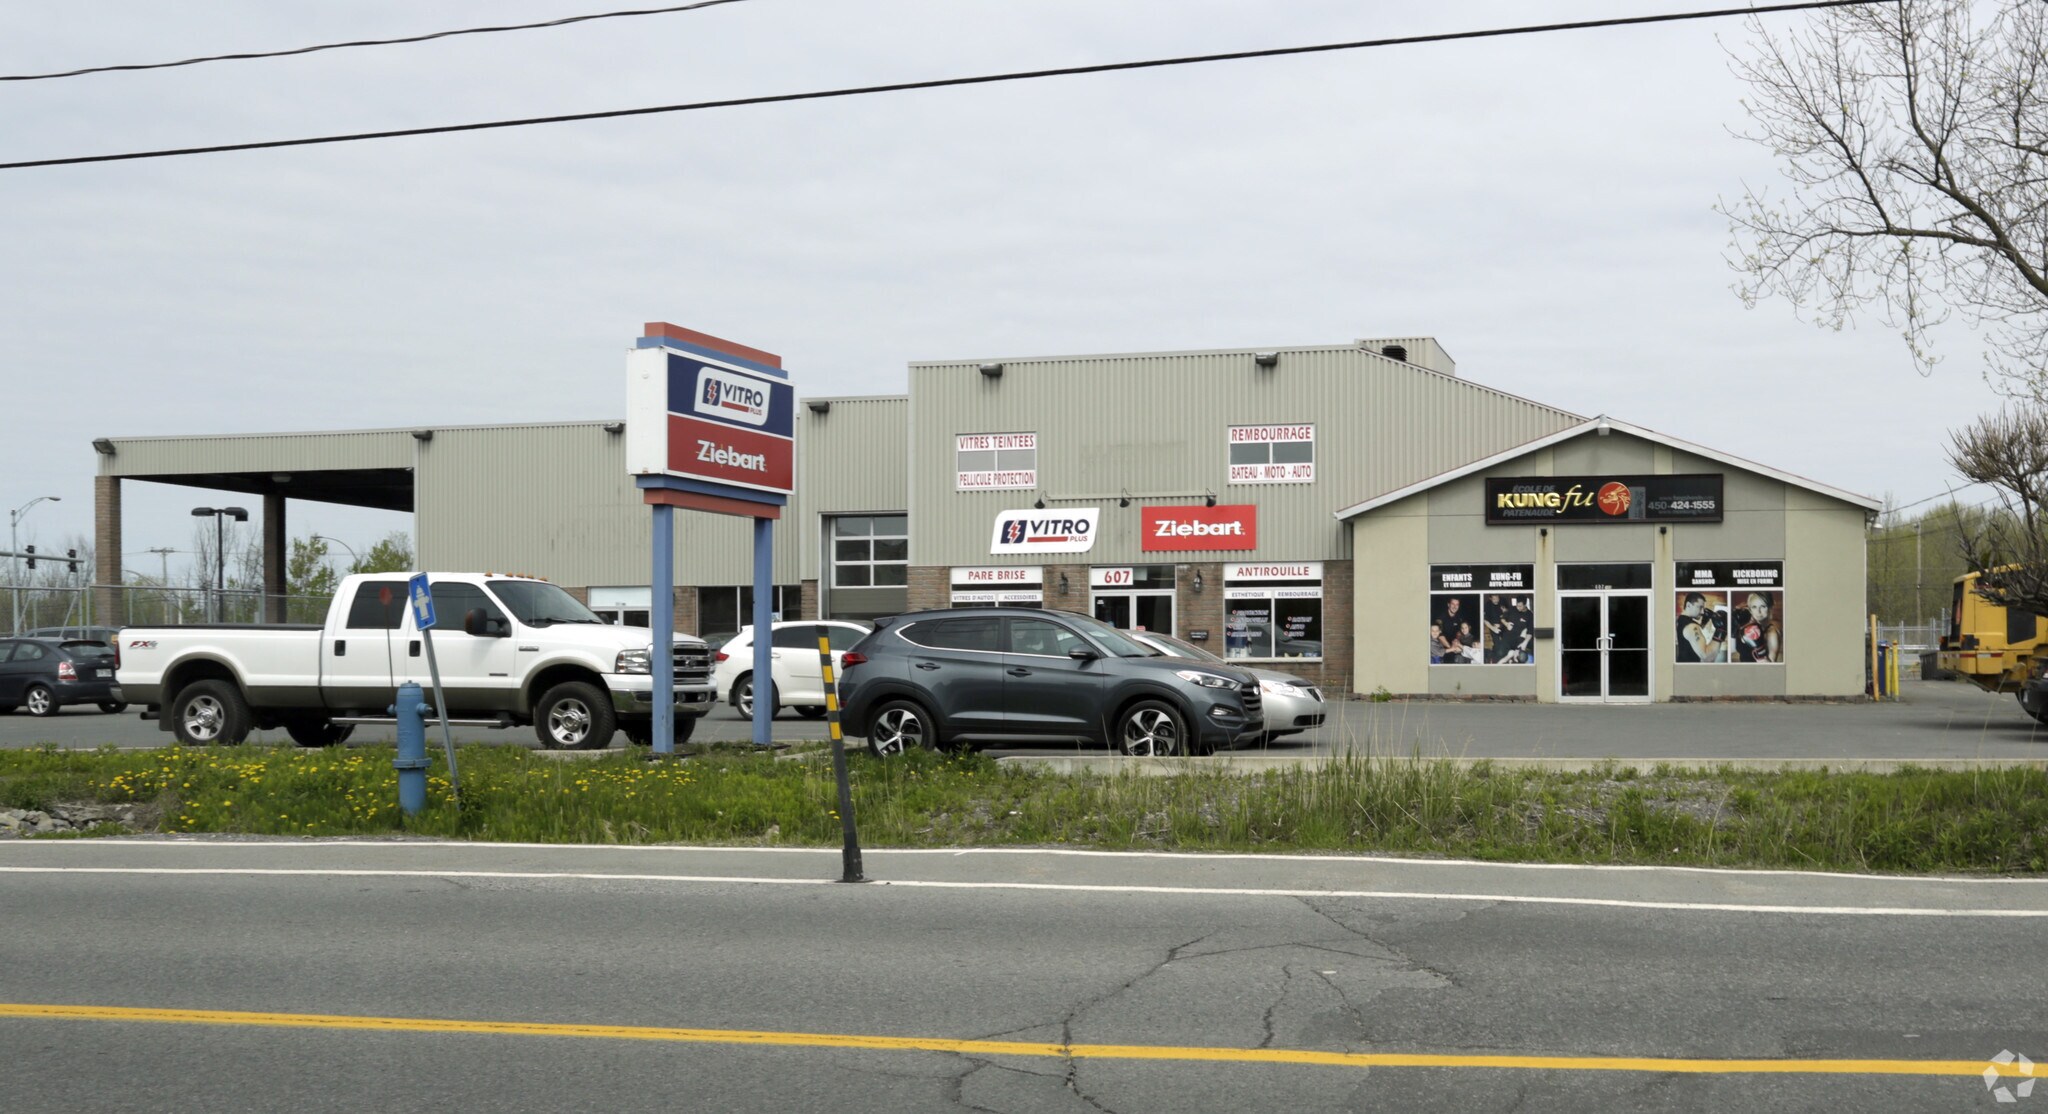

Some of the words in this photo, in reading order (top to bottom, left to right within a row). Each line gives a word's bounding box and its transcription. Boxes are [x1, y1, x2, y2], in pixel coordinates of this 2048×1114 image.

[723, 382, 764, 407] VITRO
[750, 407, 762, 416] PLUS
[1231, 427, 1312, 441] REMBOURRAGE
[960, 436, 990, 449] VITRES
[992, 435, 1034, 448] TEINTEES
[696, 439, 766, 472] Ziebart
[1231, 466, 1258, 479] BATEAU
[1264, 465, 1286, 479] MOTO
[1292, 465, 1312, 478] AUTO
[960, 473, 992, 486] PELLICULE
[994, 472, 1035, 485] PROTECTION
[1542, 484, 1556, 492] DE
[1503, 509, 1555, 517] PATENAUDE
[1030, 518, 1090, 535] VITRO
[968, 570, 993, 580] PARE
[997, 570, 1026, 580] BRISE
[1236, 566, 1310, 576] ANTIROUILLE
[1694, 569, 1713, 578] MMA
[1732, 569, 1778, 578] KICKBOXING
[1104, 570, 1130, 583] 607
[1442, 573, 1473, 582] ENFANTS
[1490, 572, 1522, 581] KUNG-FU
